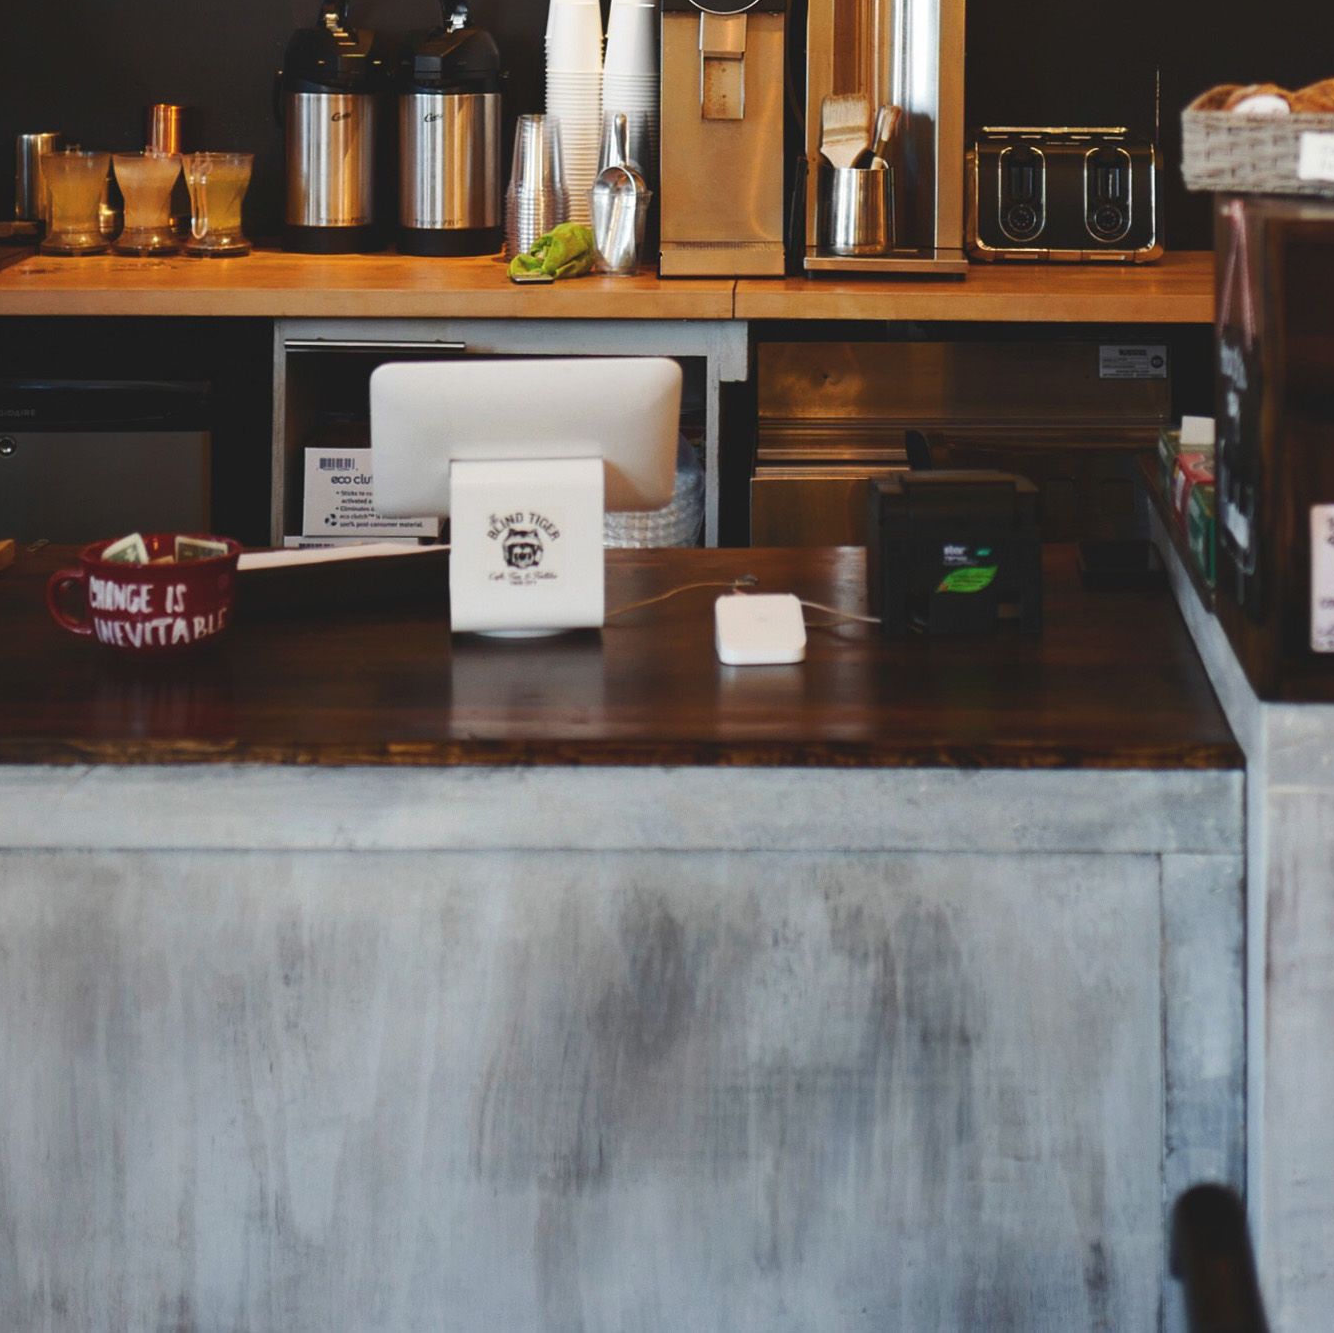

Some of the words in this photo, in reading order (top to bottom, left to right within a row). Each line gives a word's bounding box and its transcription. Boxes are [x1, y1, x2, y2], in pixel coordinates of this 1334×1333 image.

[486, 512, 523, 541] BLIND
[529, 512, 561, 542] TIGER
[89, 575, 154, 614] CHANGE
[165, 583, 187, 614] IS
[94, 607, 228, 648] INEVITABLE
